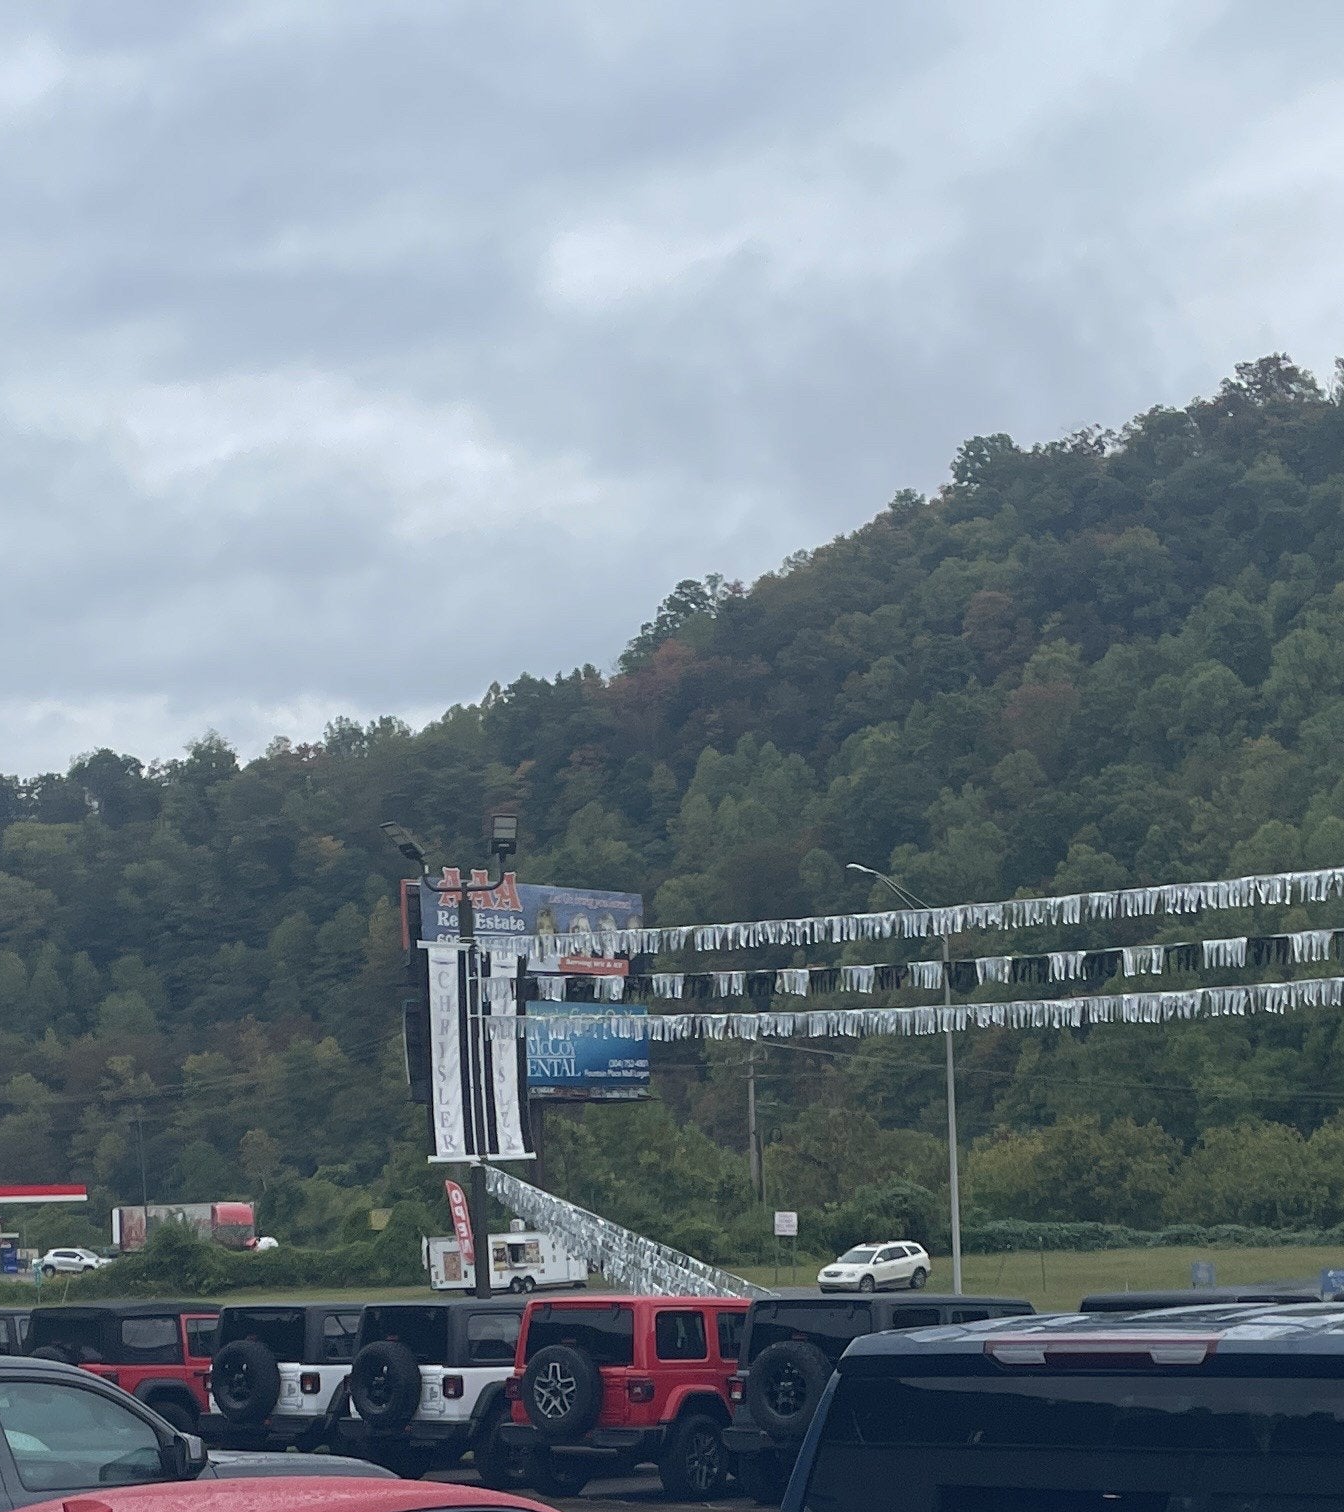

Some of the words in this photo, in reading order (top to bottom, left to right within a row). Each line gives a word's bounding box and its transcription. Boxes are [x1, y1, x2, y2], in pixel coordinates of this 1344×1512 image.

[475, 912, 525, 931] Estate
[437, 970, 456, 1150] CHRYSLER
[527, 1058, 582, 1077] ENTAL
